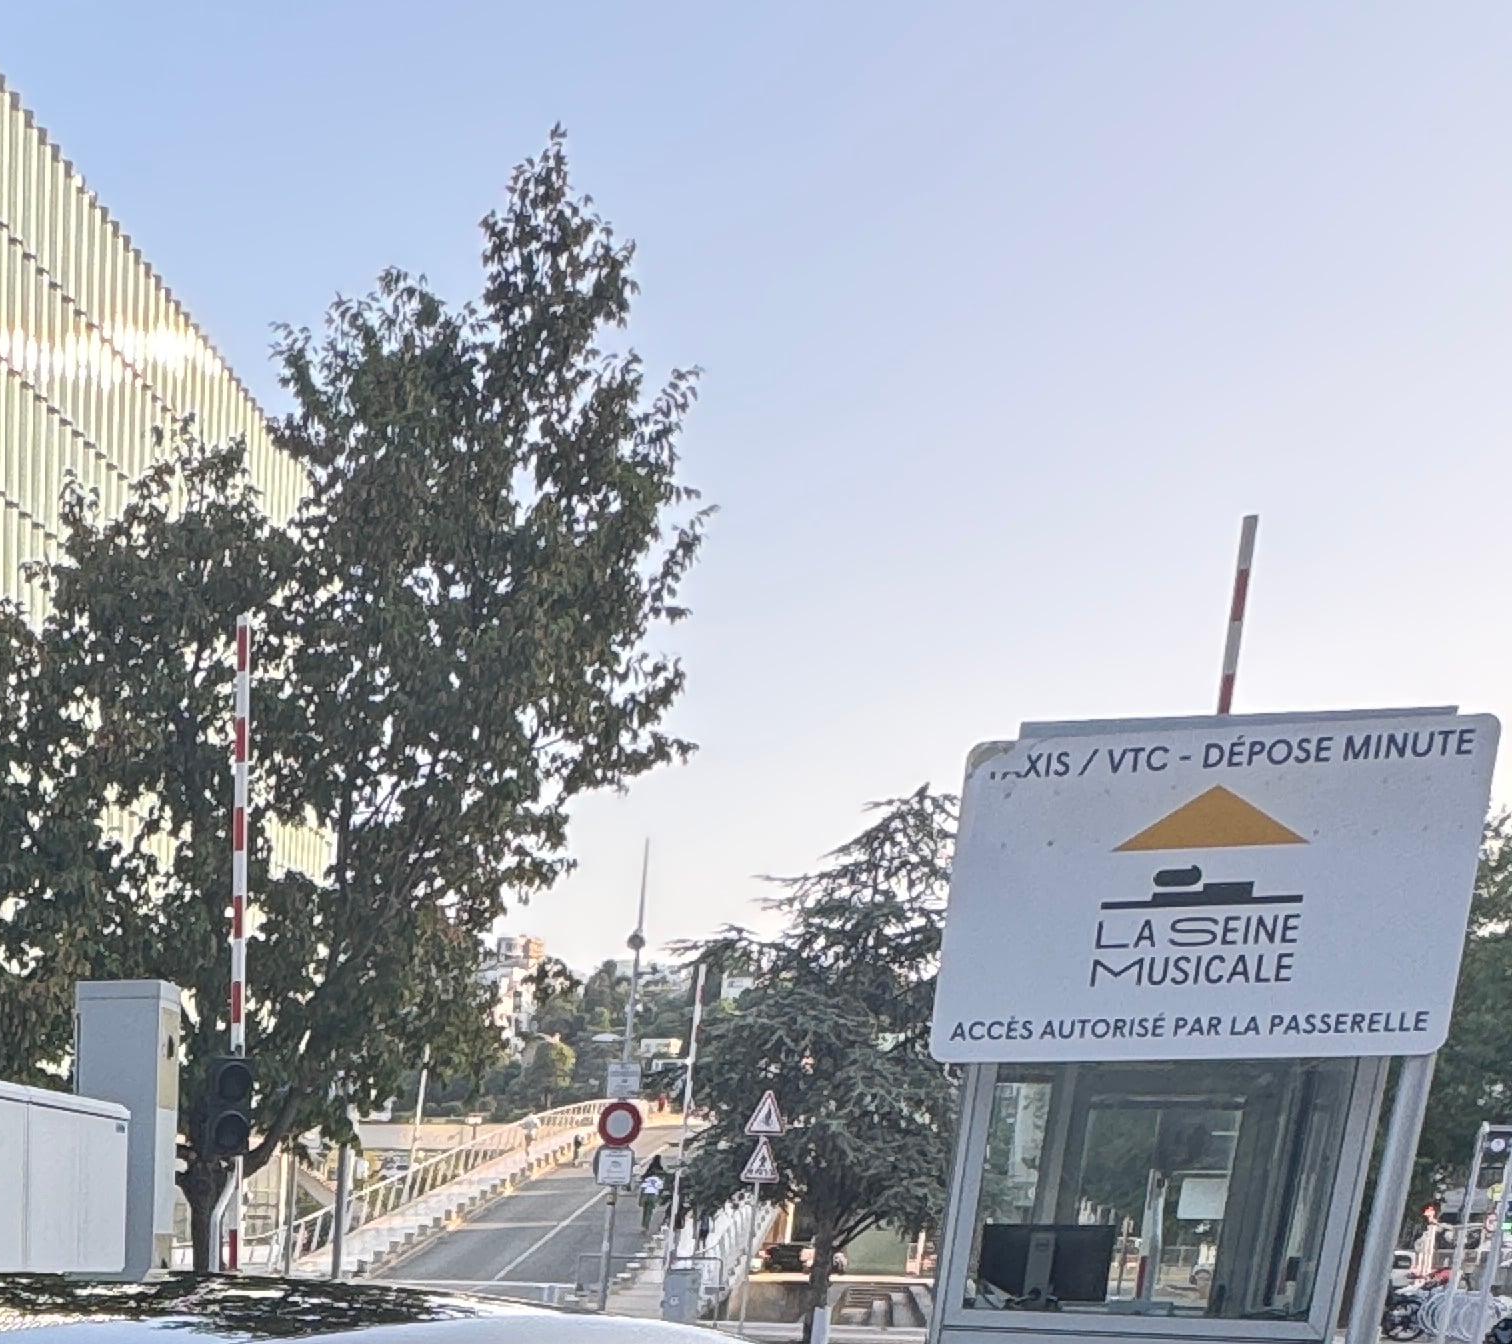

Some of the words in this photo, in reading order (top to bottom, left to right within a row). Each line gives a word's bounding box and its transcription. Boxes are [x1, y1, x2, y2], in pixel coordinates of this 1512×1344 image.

[990, 750, 1070, 781] XIS
[1077, 748, 1100, 777] /
[1106, 745, 1171, 774] VTC
[1201, 734, 1335, 770] DÉPOSE
[1342, 728, 1477, 763] MINUTE
[1094, 918, 1156, 951] LA
[1168, 912, 1302, 948] SEINE
[1089, 952, 1295, 988] MUSICALE
[949, 1016, 1034, 1043] ACCÈS
[1039, 1012, 1167, 1041] AUTORISÉ
[1172, 1016, 1223, 1039] PAR
[1229, 1015, 1262, 1036] LA
[1268, 1010, 1430, 1036] PASSERELLE
